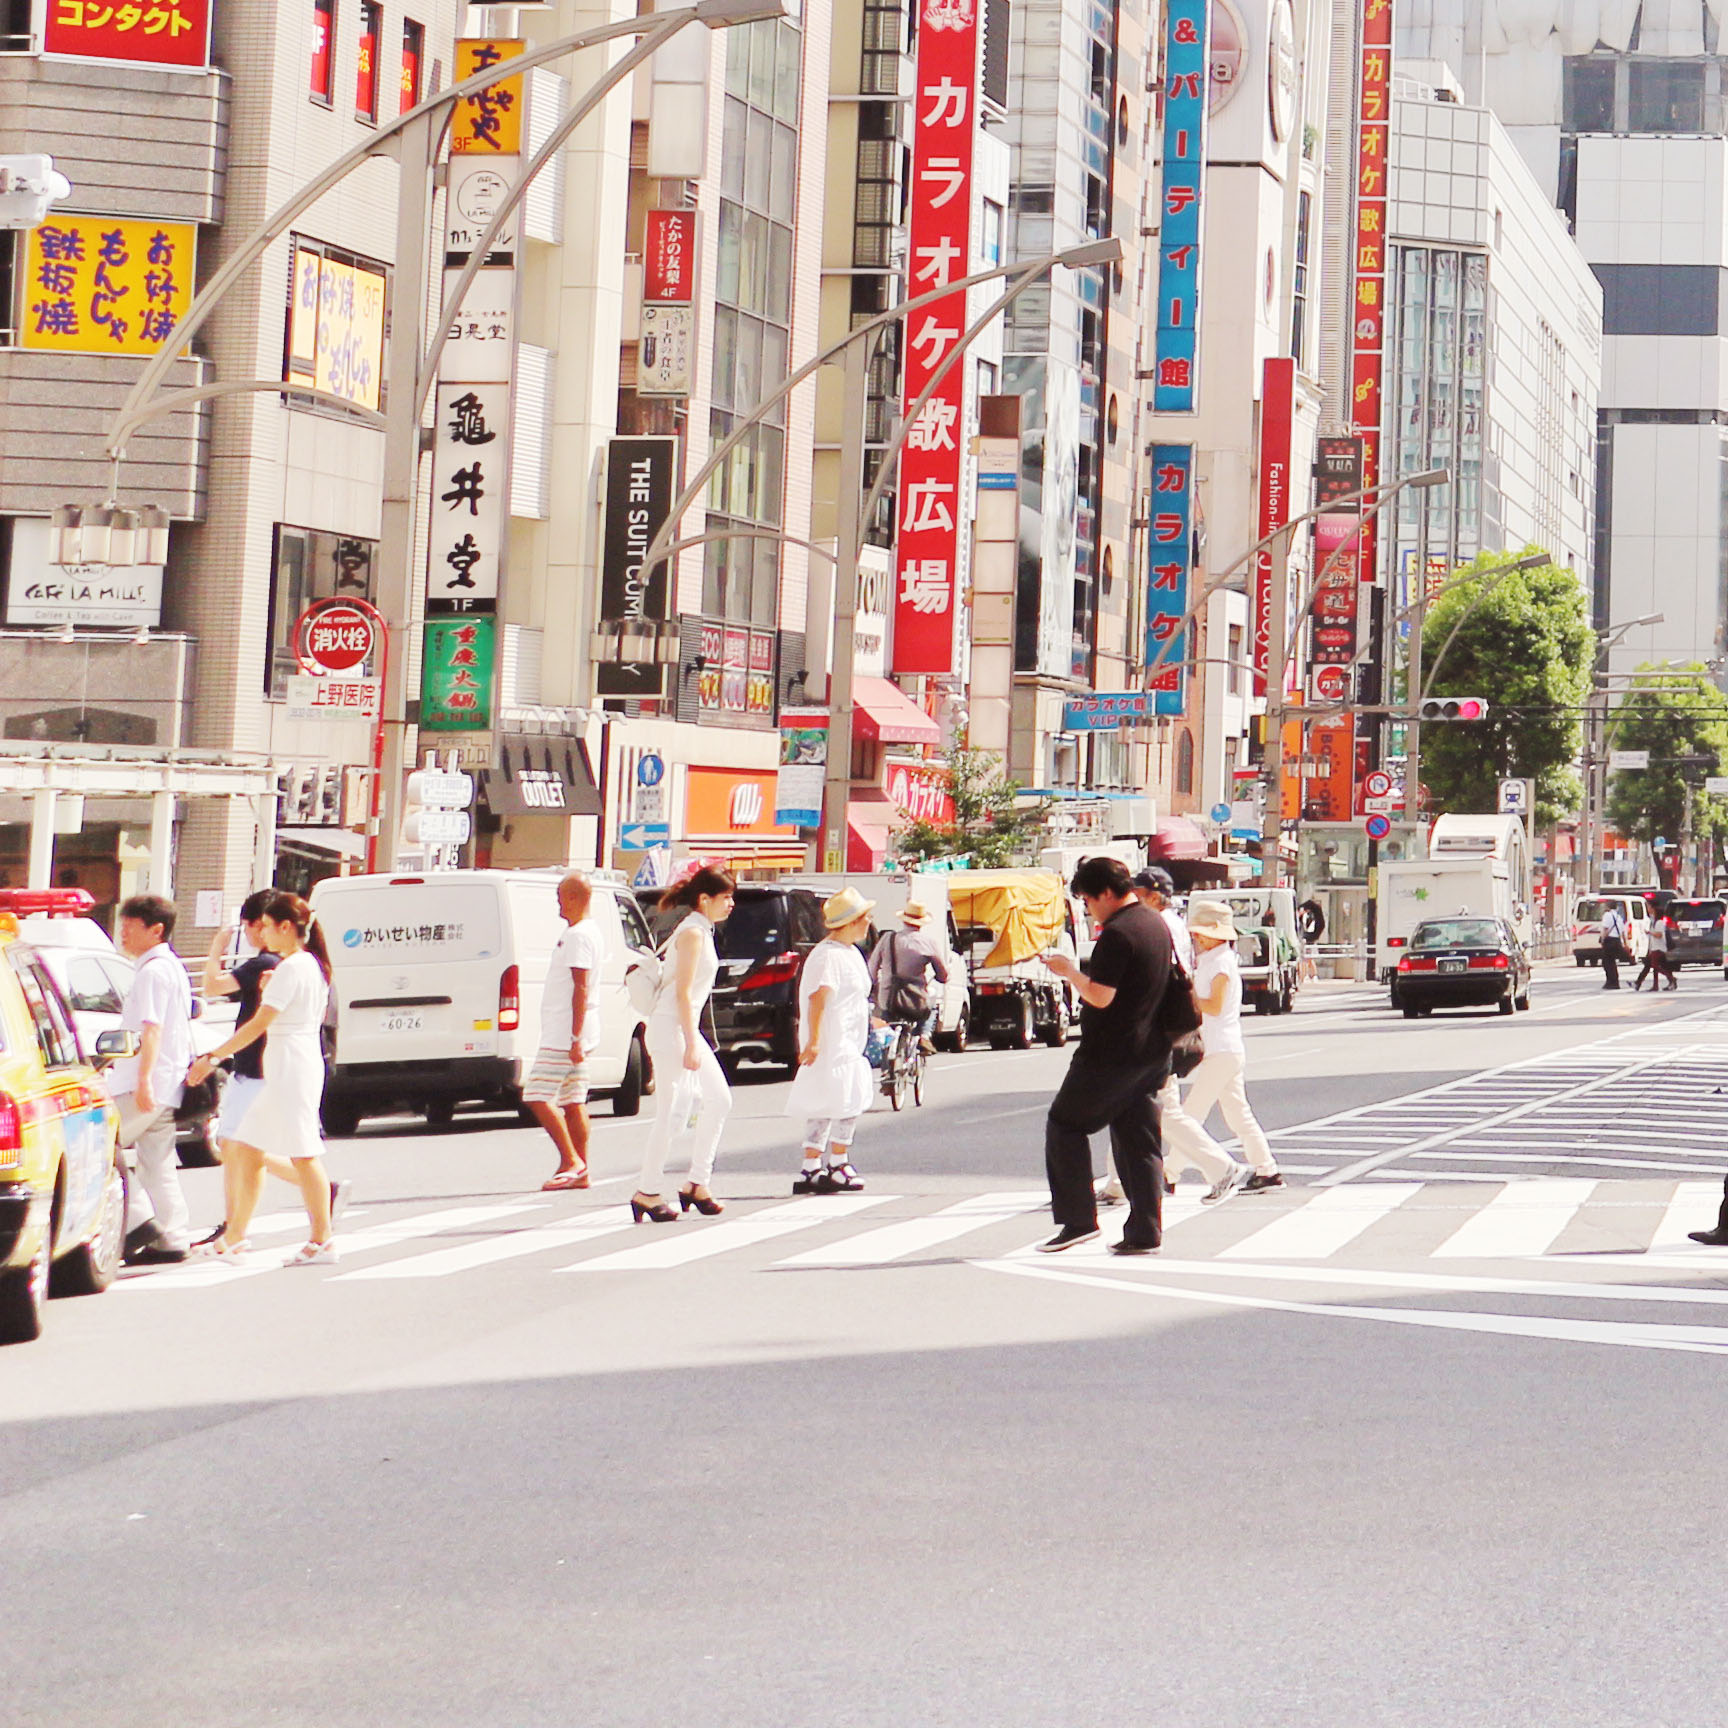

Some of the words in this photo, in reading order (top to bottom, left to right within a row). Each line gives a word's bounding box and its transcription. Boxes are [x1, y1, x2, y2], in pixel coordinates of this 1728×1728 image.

[56, 0, 193, 37] コンタクト
[1358, 55, 1384, 305] カラオケ歌広場
[33, 226, 87, 337] 鉄板焼
[90, 228, 130, 344] もんじゃ
[660, 286, 677, 298] 4F
[900, 75, 970, 616] カラオケ歌広場
[630, 457, 651, 503] THE
[452, 599, 473, 612] 1F
[313, 626, 368, 653] 消火栓
[311, 683, 375, 708] 上野医院
[521, 781, 565, 809] OUTLET
